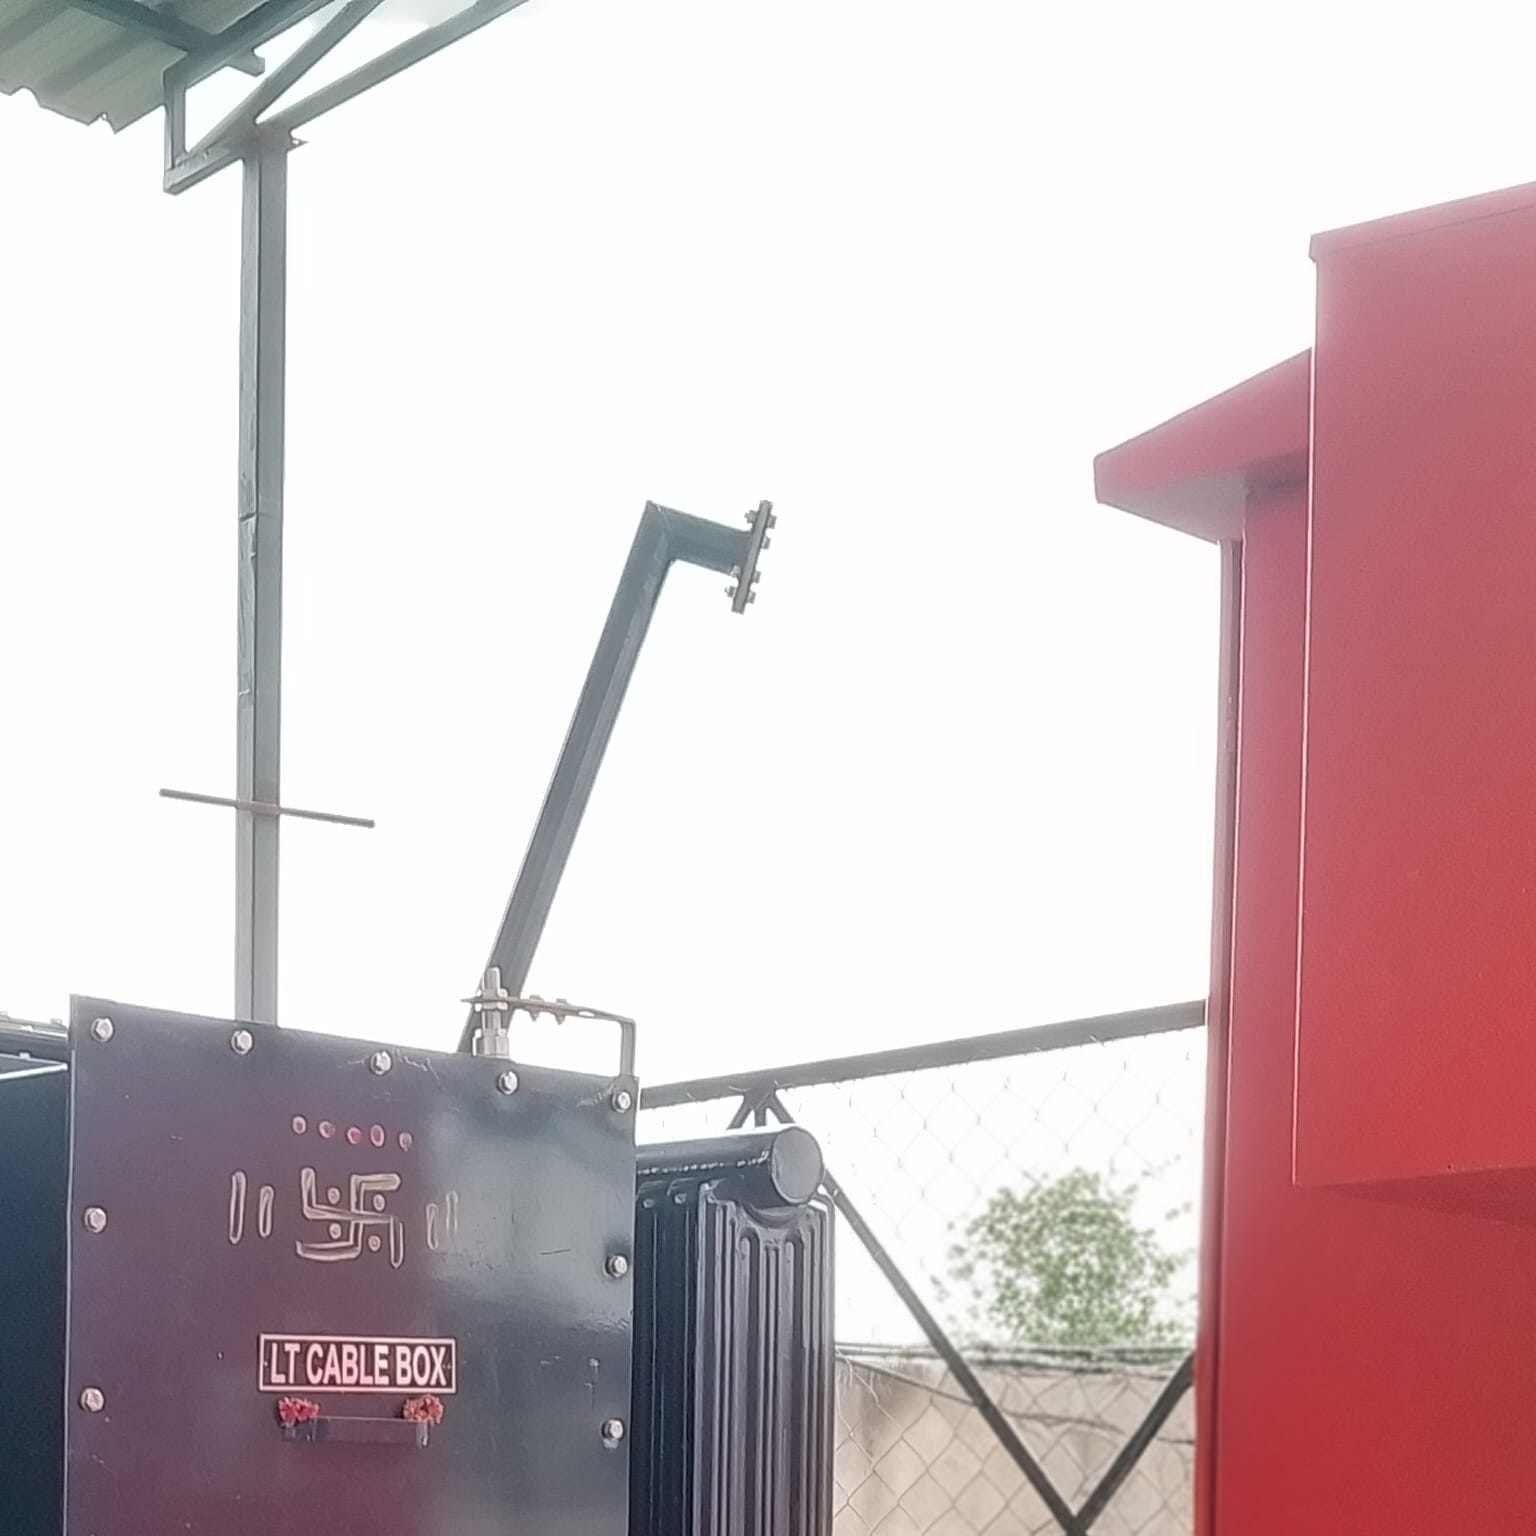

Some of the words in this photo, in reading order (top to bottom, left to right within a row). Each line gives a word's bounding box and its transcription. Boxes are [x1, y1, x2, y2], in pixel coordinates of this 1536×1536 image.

[270, 1342, 301, 1384] LT
[306, 1343, 390, 1386] CABLE
[396, 1345, 447, 1387] BOX
